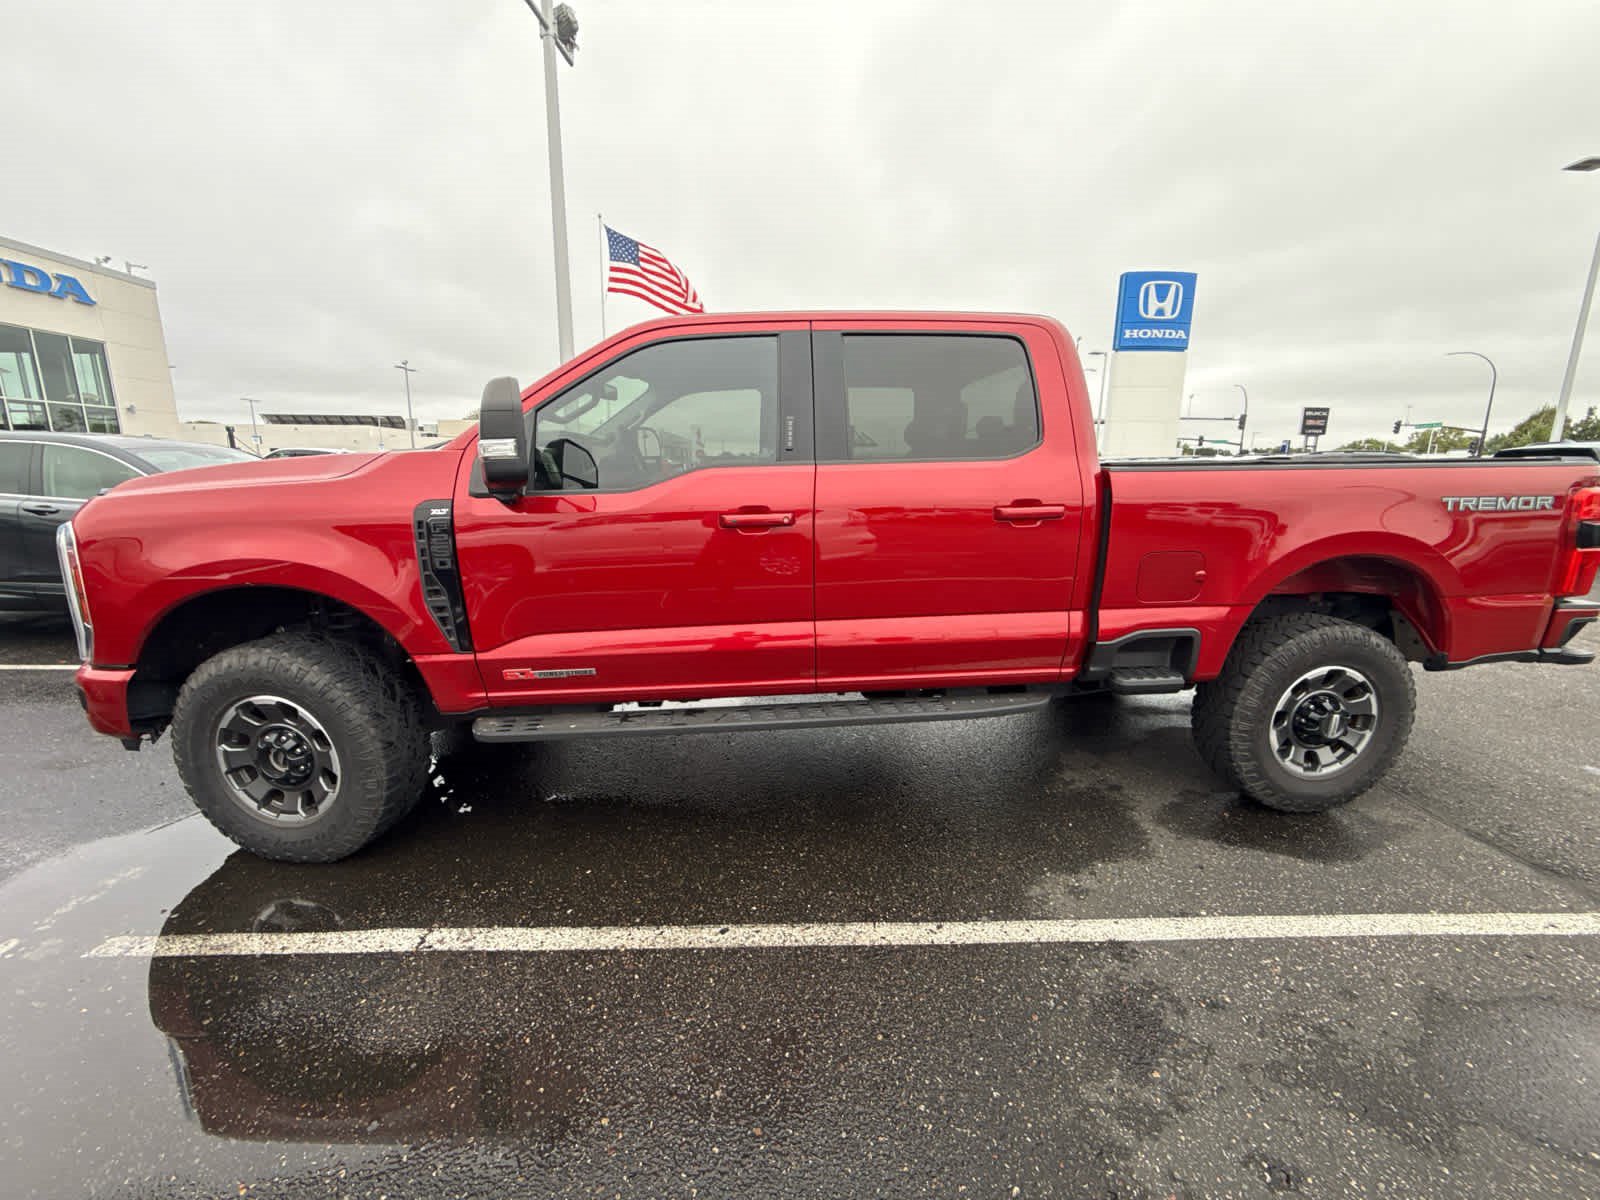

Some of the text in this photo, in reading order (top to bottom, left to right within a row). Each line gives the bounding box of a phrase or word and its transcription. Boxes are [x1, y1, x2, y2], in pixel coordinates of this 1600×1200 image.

[0, 258, 97, 305] DA
[1123, 329, 1187, 338] HONDA
[1442, 496, 1554, 511] TREMOR
[538, 671, 566, 679] POWER
